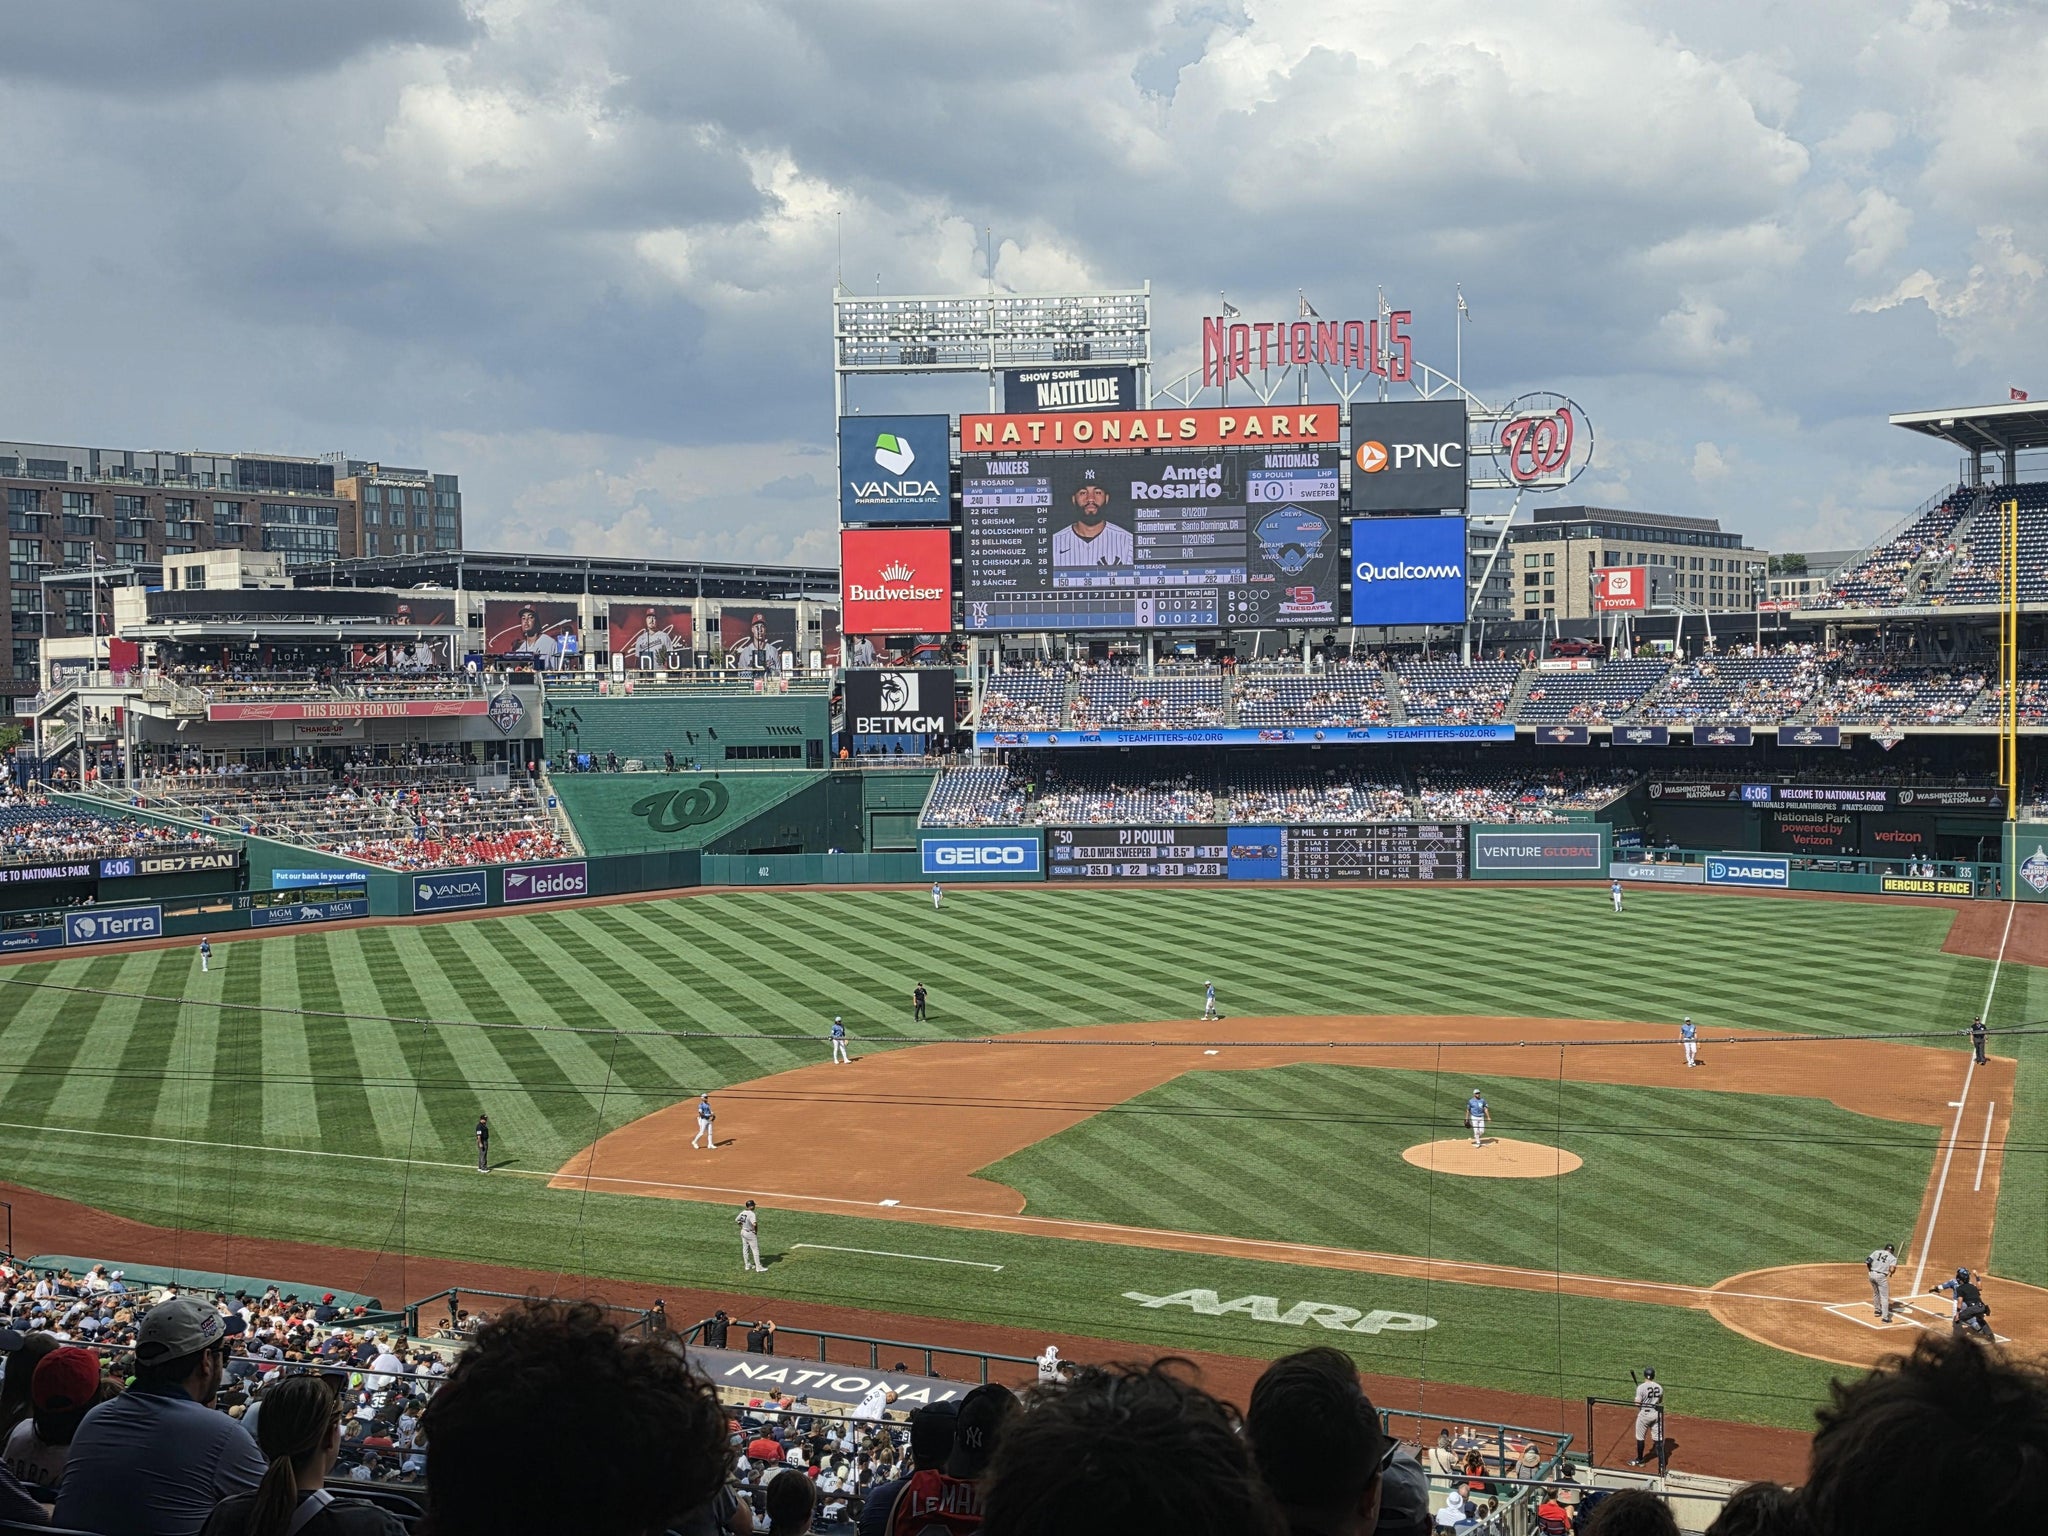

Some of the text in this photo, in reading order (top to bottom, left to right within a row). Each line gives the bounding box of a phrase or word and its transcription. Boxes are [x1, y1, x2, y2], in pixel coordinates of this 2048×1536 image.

[1203, 310, 1411, 387] NATIONALS
[1019, 370, 1080, 382] SHOW SOME
[1037, 377, 1119, 406] NATITUDE
[974, 413, 1319, 443] NATIONALS PARK
[1264, 453, 1320, 469] NATIONALS
[1392, 442, 1462, 469] PNC
[986, 461, 1029, 475] YANKEES
[1161, 463, 1222, 480] Amed
[1265, 471, 1294, 479] POULIN
[851, 480, 941, 498] VANDA
[981, 479, 1015, 487] ROSARIO
[1319, 482, 1336, 490] 78.0
[1131, 480, 1222, 500] Rosario
[1300, 490, 1336, 498] SWEEPER
[1181, 521, 1200, 531] Santo
[982, 558, 1020, 566] CHISHOLM
[1021, 558, 1033, 566] JR.
[1356, 562, 1462, 583] Qualcomm
[1058, 578, 1070, 587] 150
[850, 585, 944, 602] Budweiser
[1603, 598, 1636, 607] TOYOTA
[277, 653, 305, 661] LOFT
[62, 665, 87, 675] TEAM STORE
[302, 705, 327, 717] THIS
[329, 704, 361, 716] BUD'S
[364, 703, 383, 715] FOR
[385, 703, 410, 715] YOU.
[856, 716, 944, 734] BETMGM
[1079, 733, 1224, 743] MCA STEAMFITTERS-602.ORG
[1347, 729, 1497, 739] MCA STEAMFITTERS-602.ORG
[1664, 785, 1711, 794] WASHINGTON
[1686, 790, 1726, 799] NATIONALS
[1744, 787, 1768, 800] 4:06
[1780, 788, 1886, 801] WELCOME TO NATIONALS PARK
[1916, 791, 1969, 801] WASHINGTON
[1941, 796, 1986, 805] NATIONALS
[1752, 801, 1884, 812] NATIONALS PHILANTHROPIES #NATS4GOOD
[1773, 811, 1851, 823] Nationals Park
[1301, 829, 1358, 837] MIL PIT
[1782, 823, 1843, 836] powered by
[1119, 830, 1132, 844] PJ
[1134, 829, 1175, 844] POULIN
[1792, 834, 1833, 846] Verizon
[1874, 831, 1922, 843] verizon
[935, 846, 1025, 865] GEICO
[1079, 848, 1096, 858] 78.0
[1097, 848, 1115, 858] MPH
[1116, 848, 1151, 858] SWEEPER
[1483, 846, 1593, 857] VENTURE GLOBAL
[104, 860, 130, 876] 4:06
[190, 854, 233, 869] FAN
[1090, 865, 1108, 875] 35.0
[1129, 865, 1140, 874] 22
[1165, 865, 1179, 875] 3-0
[1199, 865, 1217, 875] 2.83
[9, 870, 20, 881] TO
[22, 866, 67, 881] NATIONALS
[68, 865, 90, 877] PARK
[758, 866, 770, 877] 402
[1639, 868, 1655, 877] RTX
[1727, 866, 1786, 879] DABOS
[1959, 867, 1972, 878] 335
[433, 881, 481, 897] VANDA
[531, 872, 584, 894] leidos
[1884, 879, 1970, 894] HERCULES FENCE
[238, 896, 250, 909] 377
[269, 903, 352, 918] MGM MGM
[97, 917, 154, 935] Terra
[1877, 1252, 1889, 1263] 14
[1121, 1288, 1439, 1335] AARP
[1647, 1386, 1661, 1399] 22
[371, 1395, 387, 1408] 35
[787, 1456, 799, 1467] 99
